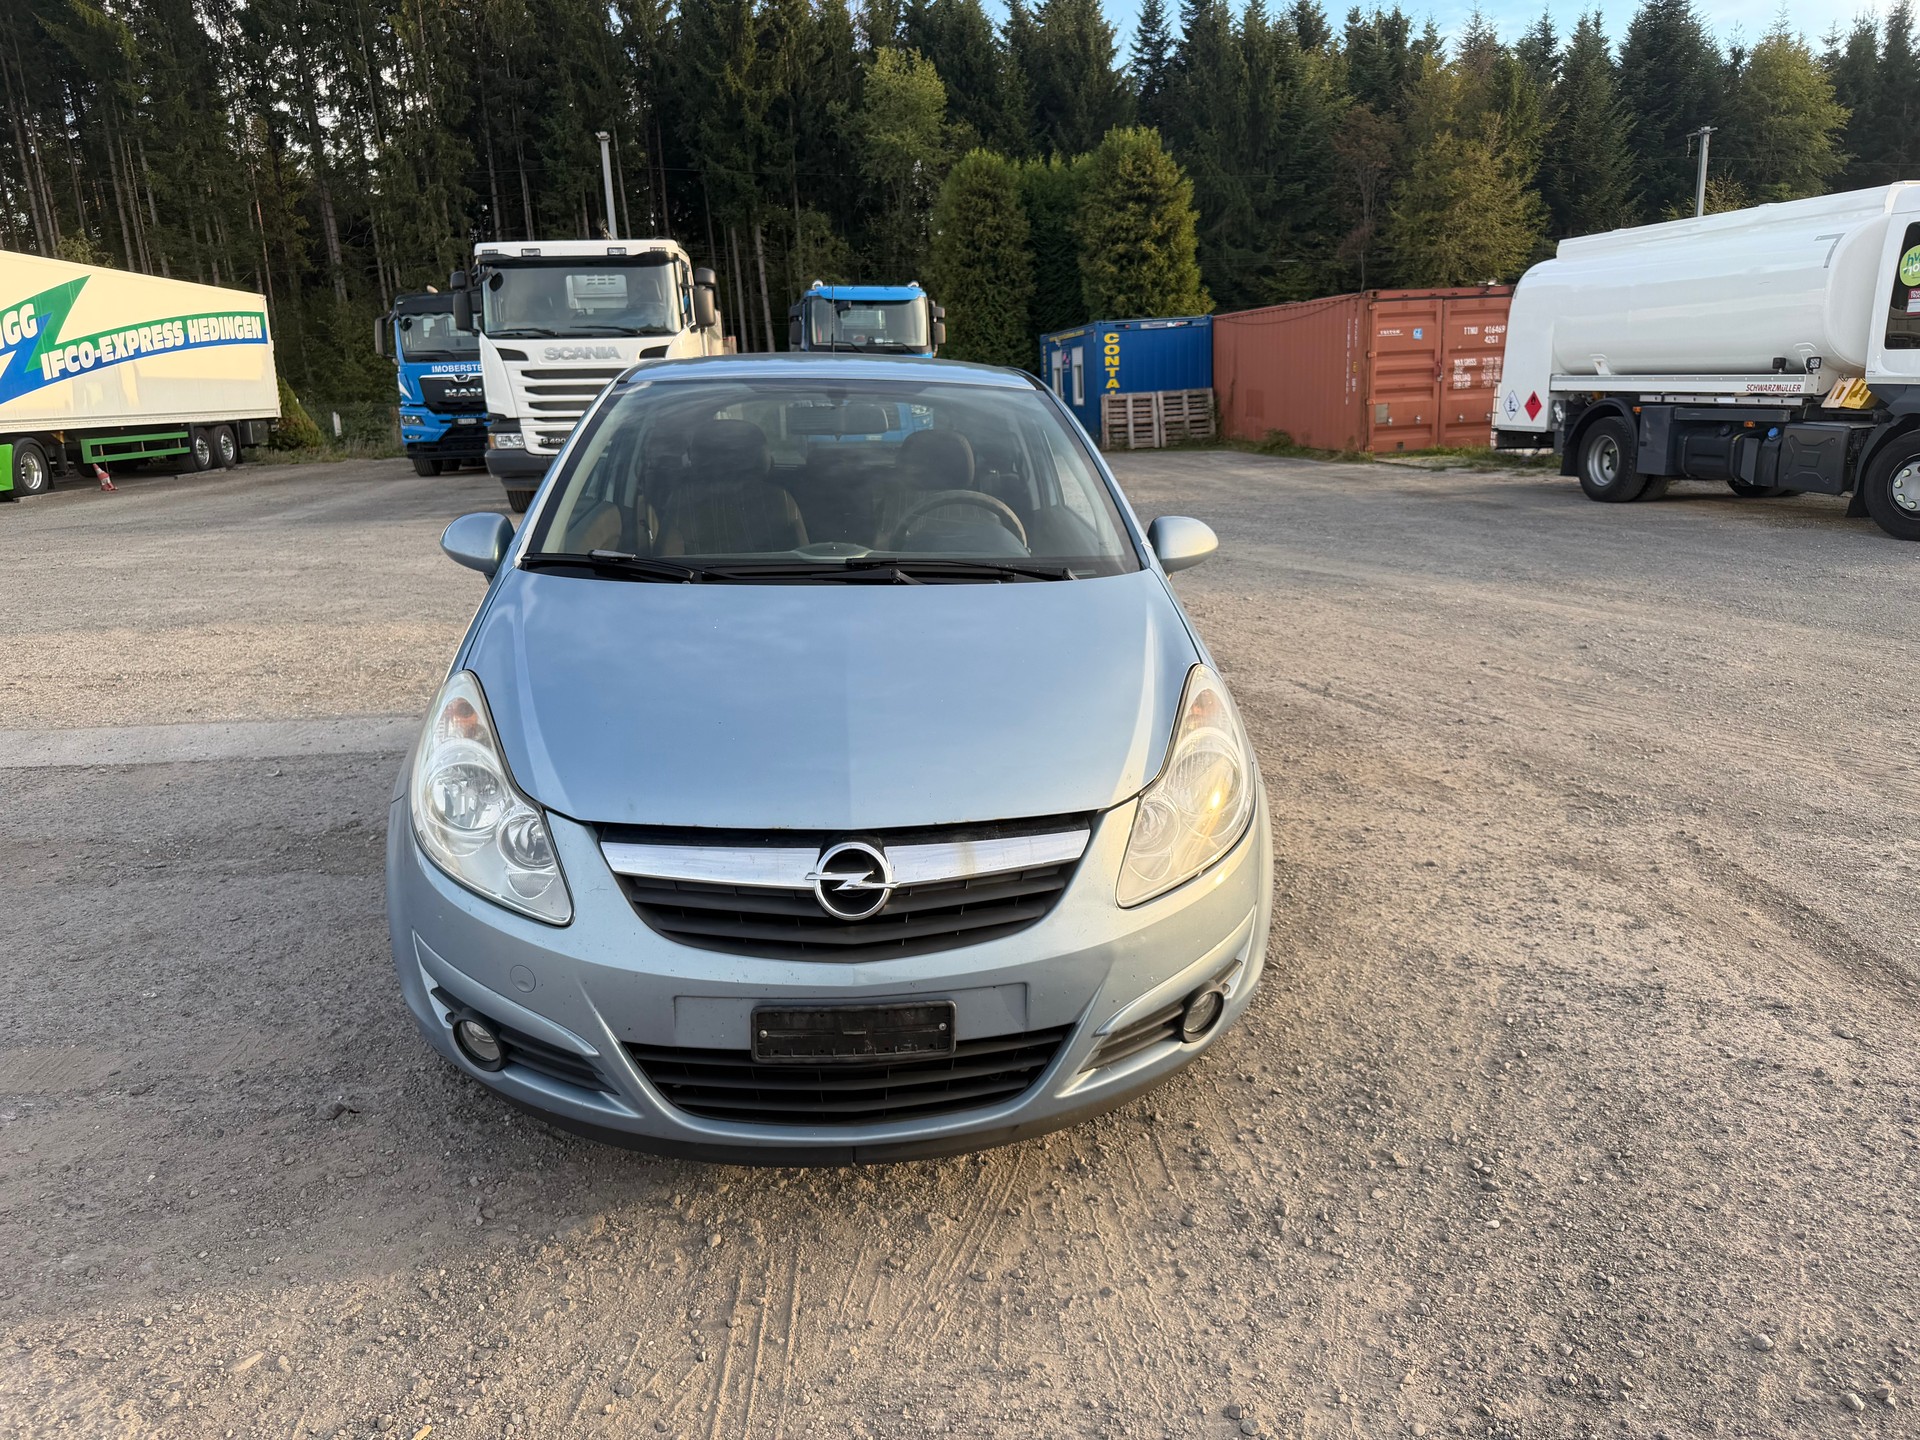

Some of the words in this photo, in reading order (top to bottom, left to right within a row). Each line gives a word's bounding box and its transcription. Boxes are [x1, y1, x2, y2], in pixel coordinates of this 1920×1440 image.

[40, 320, 185, 381] IFCO-EXPRESS
[187, 315, 263, 343] HEDINGEN
[544, 346, 622, 360] SCANIA
[444, 387, 482, 397] MAN
[1745, 383, 1801, 392] SCHWARZMÜLLER
